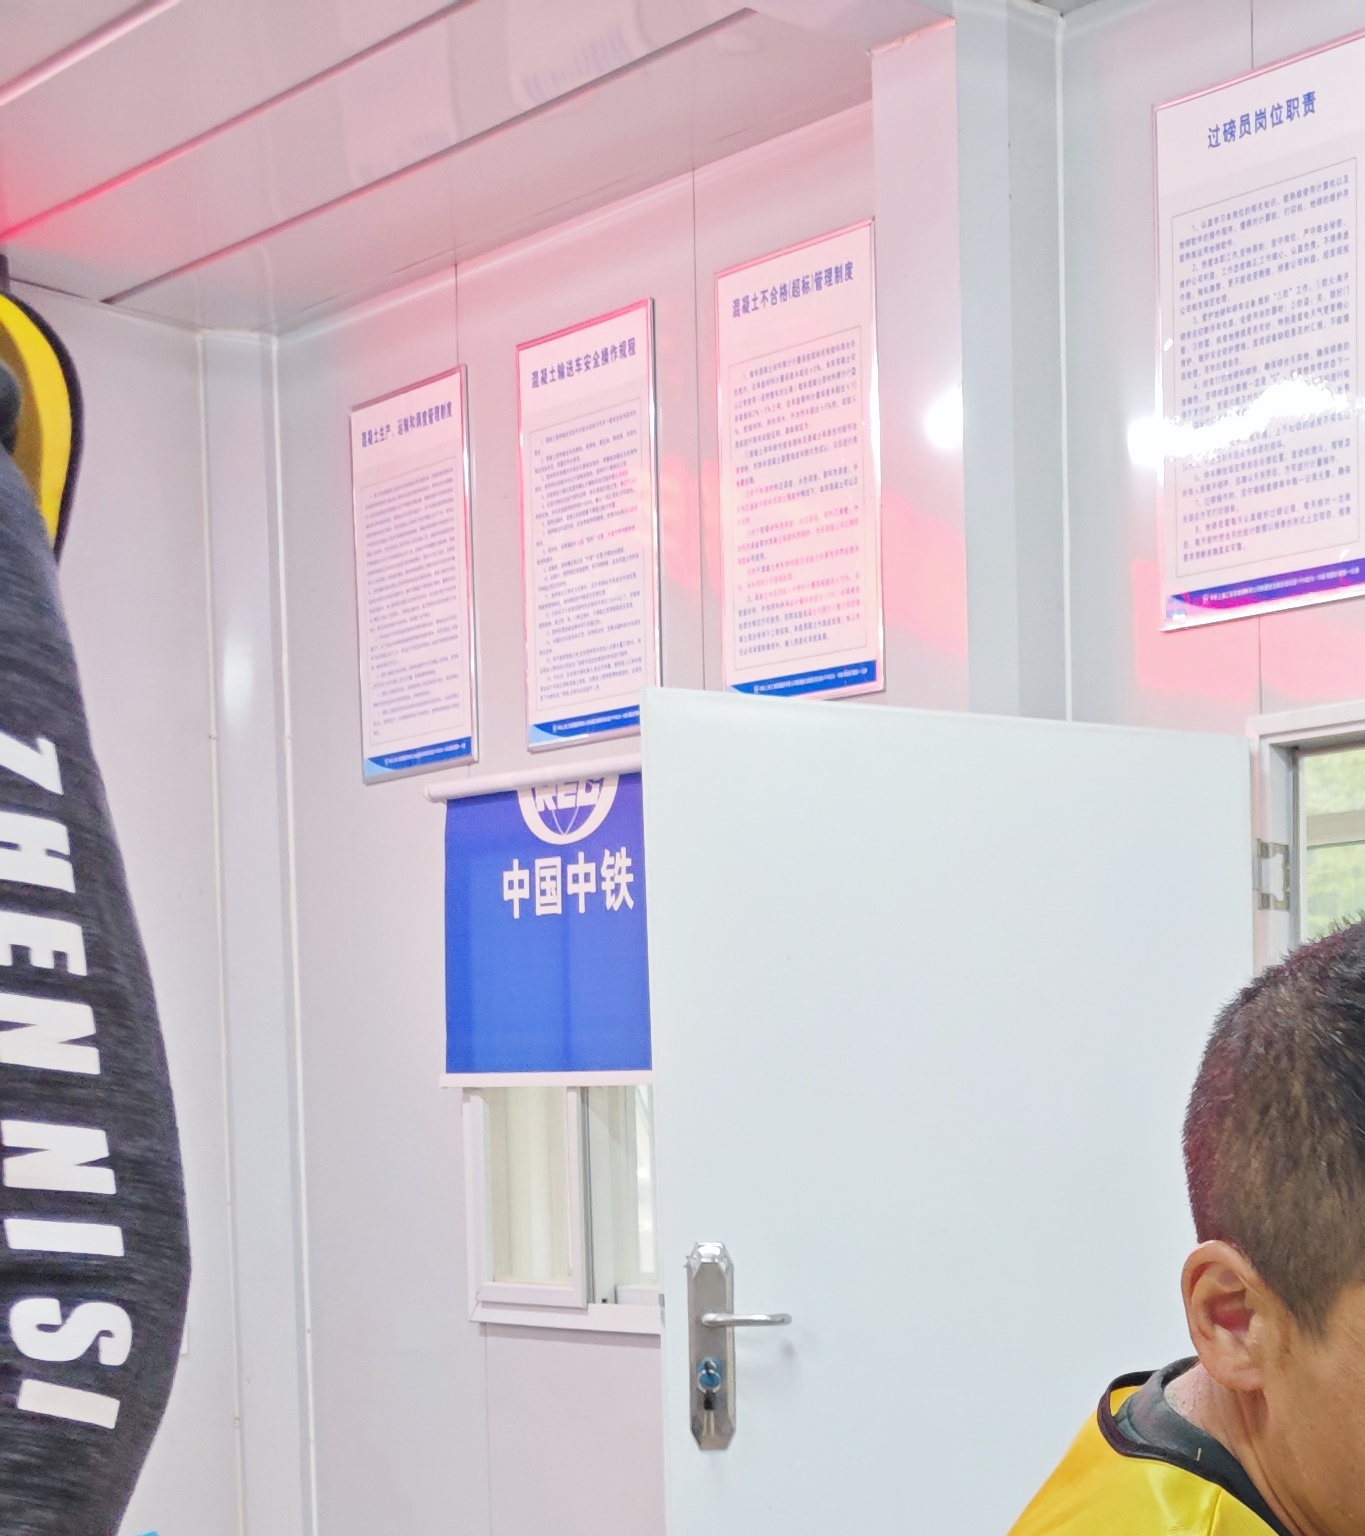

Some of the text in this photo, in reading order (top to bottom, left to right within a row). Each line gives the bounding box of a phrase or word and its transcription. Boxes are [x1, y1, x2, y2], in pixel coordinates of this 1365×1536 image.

[1206, 90, 1318, 150] 过磅员岗位职责
[503, 846, 635, 920] 中国中铁
